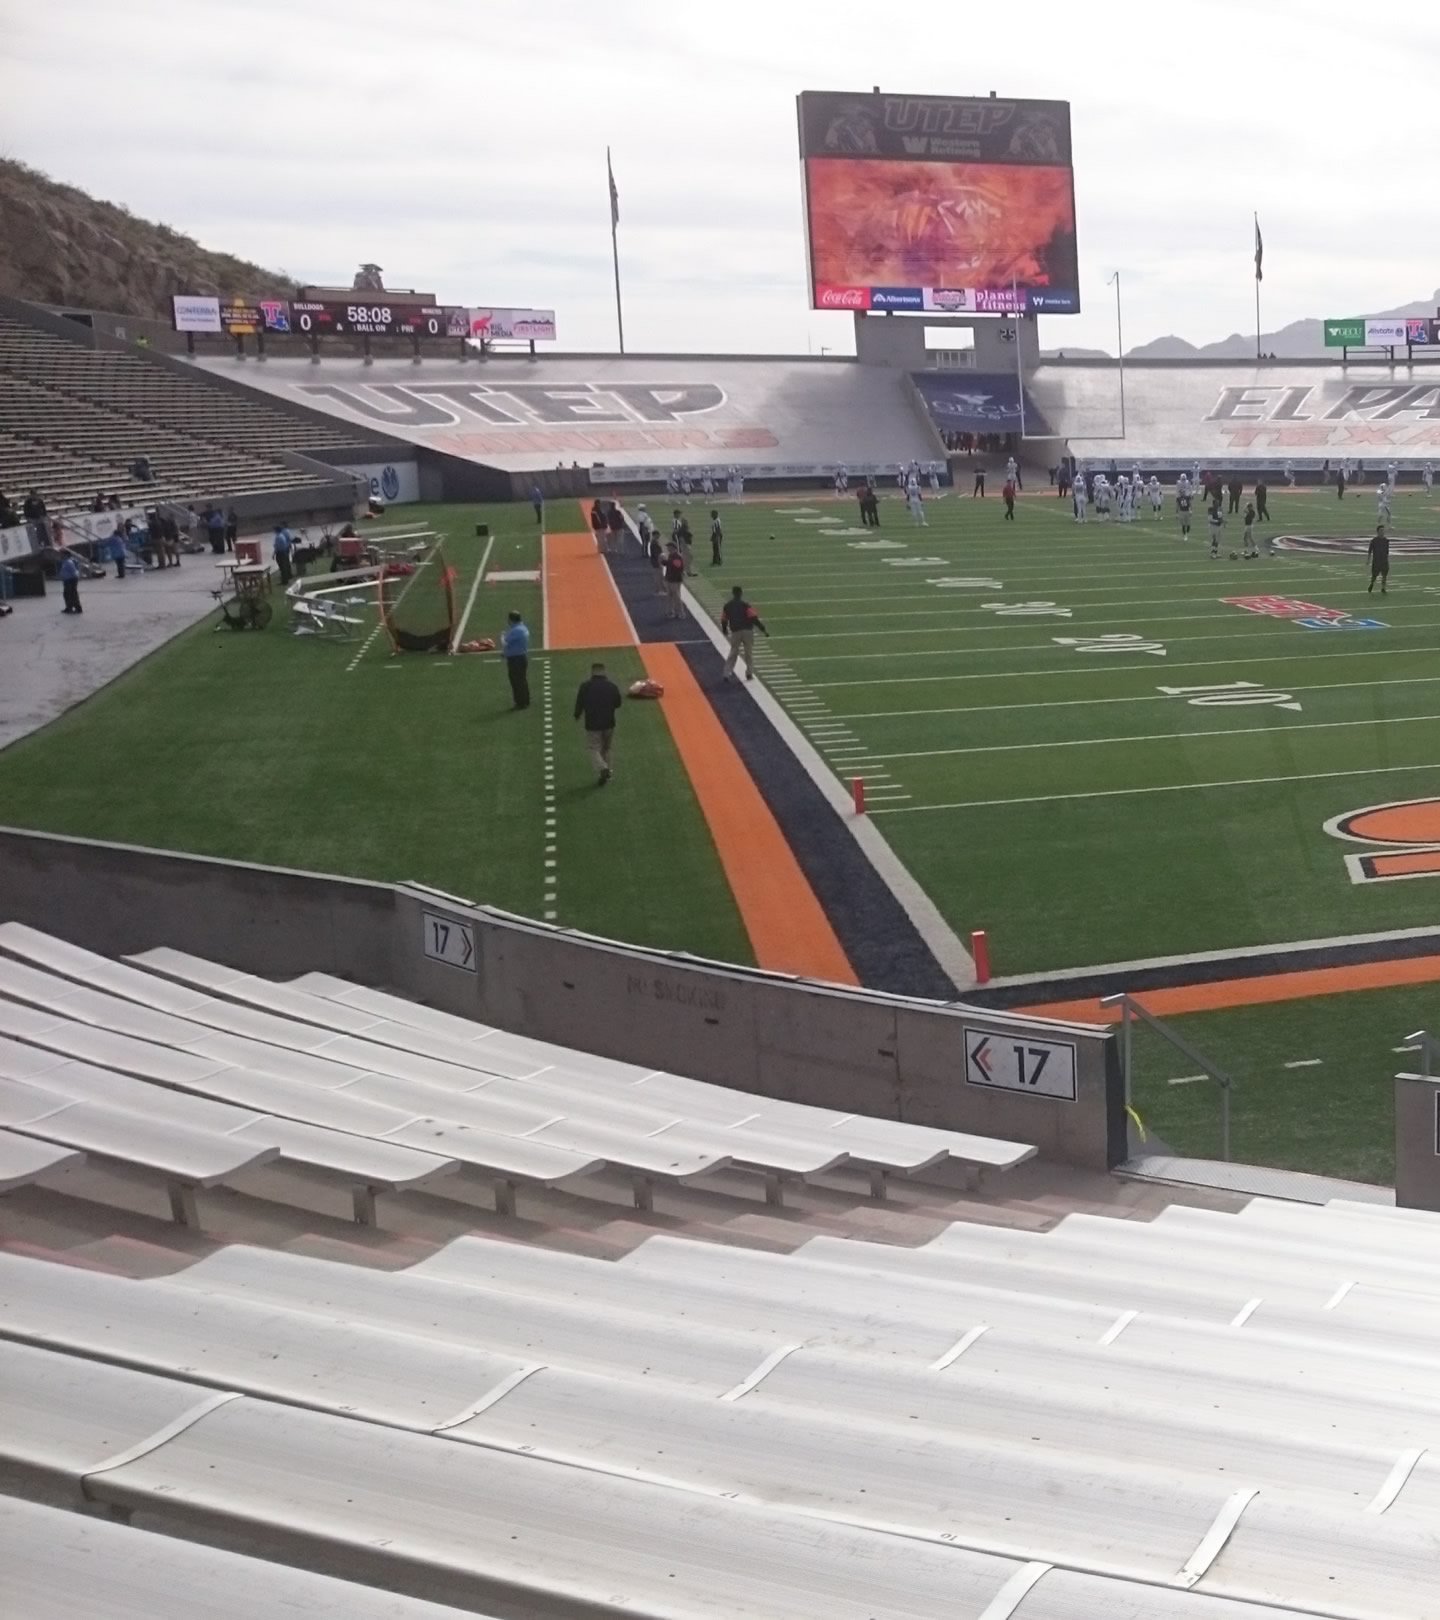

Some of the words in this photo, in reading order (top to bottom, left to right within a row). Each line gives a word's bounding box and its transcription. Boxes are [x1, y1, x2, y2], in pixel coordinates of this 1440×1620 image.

[884, 98, 1016, 135] UTEP
[293, 302, 324, 311] BULLDOGS
[347, 306, 392, 323] 58:08
[300, 314, 311, 331] 0
[428, 318, 438, 334] 0
[289, 382, 728, 427] UTEP
[1203, 385, 1316, 422] EL
[1051, 634, 1166, 655] 20
[1156, 681, 1295, 707] 10
[431, 920, 449, 954] 17
[1012, 1044, 1052, 1086] 17
